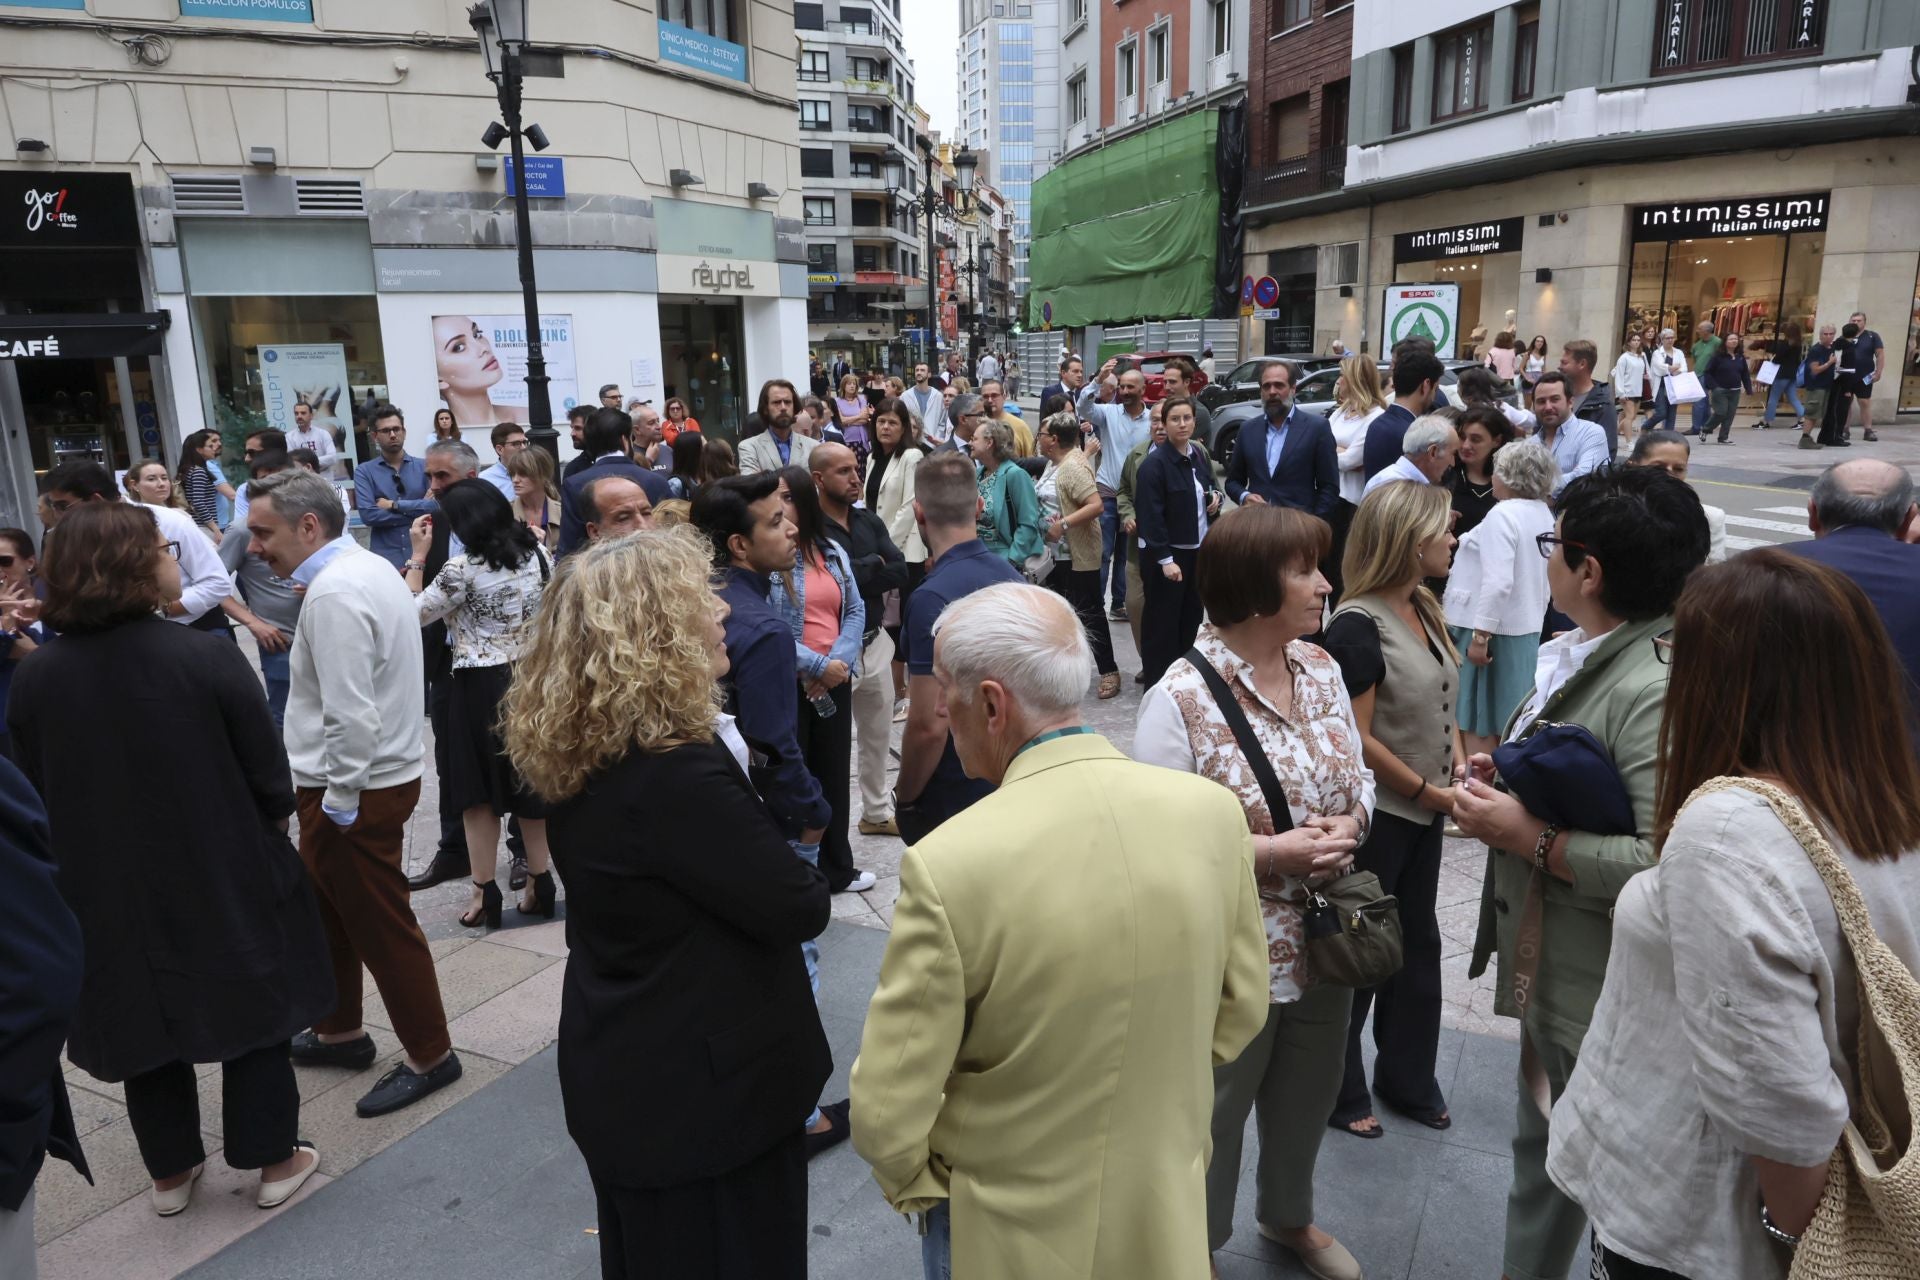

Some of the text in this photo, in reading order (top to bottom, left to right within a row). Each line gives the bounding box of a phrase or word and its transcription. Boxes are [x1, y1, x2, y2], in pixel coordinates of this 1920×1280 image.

[1463, 36, 1473, 105] NOTARIA
[1643, 199, 1824, 225] intimissimi
[1712, 216, 1821, 232] Italian lingerie
[1412, 224, 1500, 248] intimissimi
[1445, 240, 1499, 255] Italian lingerie
[0, 335, 60, 357] CAFÉ
[494, 328, 567, 343] BIOLTING
